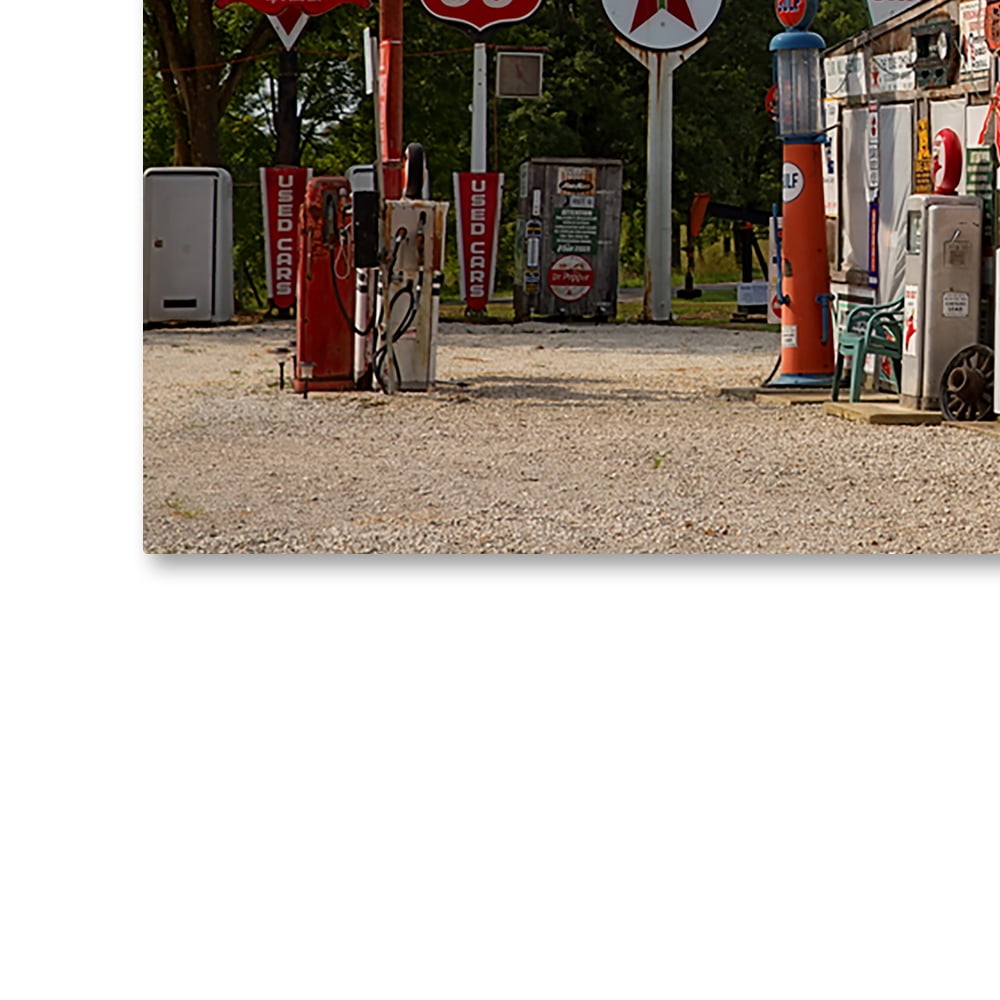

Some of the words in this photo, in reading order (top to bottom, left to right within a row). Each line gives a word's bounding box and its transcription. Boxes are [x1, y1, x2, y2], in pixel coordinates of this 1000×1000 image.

[277, 174, 293, 233] USED
[470, 179, 486, 236] USED
[782, 173, 799, 191] ULF
[276, 237, 293, 296] CARS
[470, 241, 485, 298] CARS
